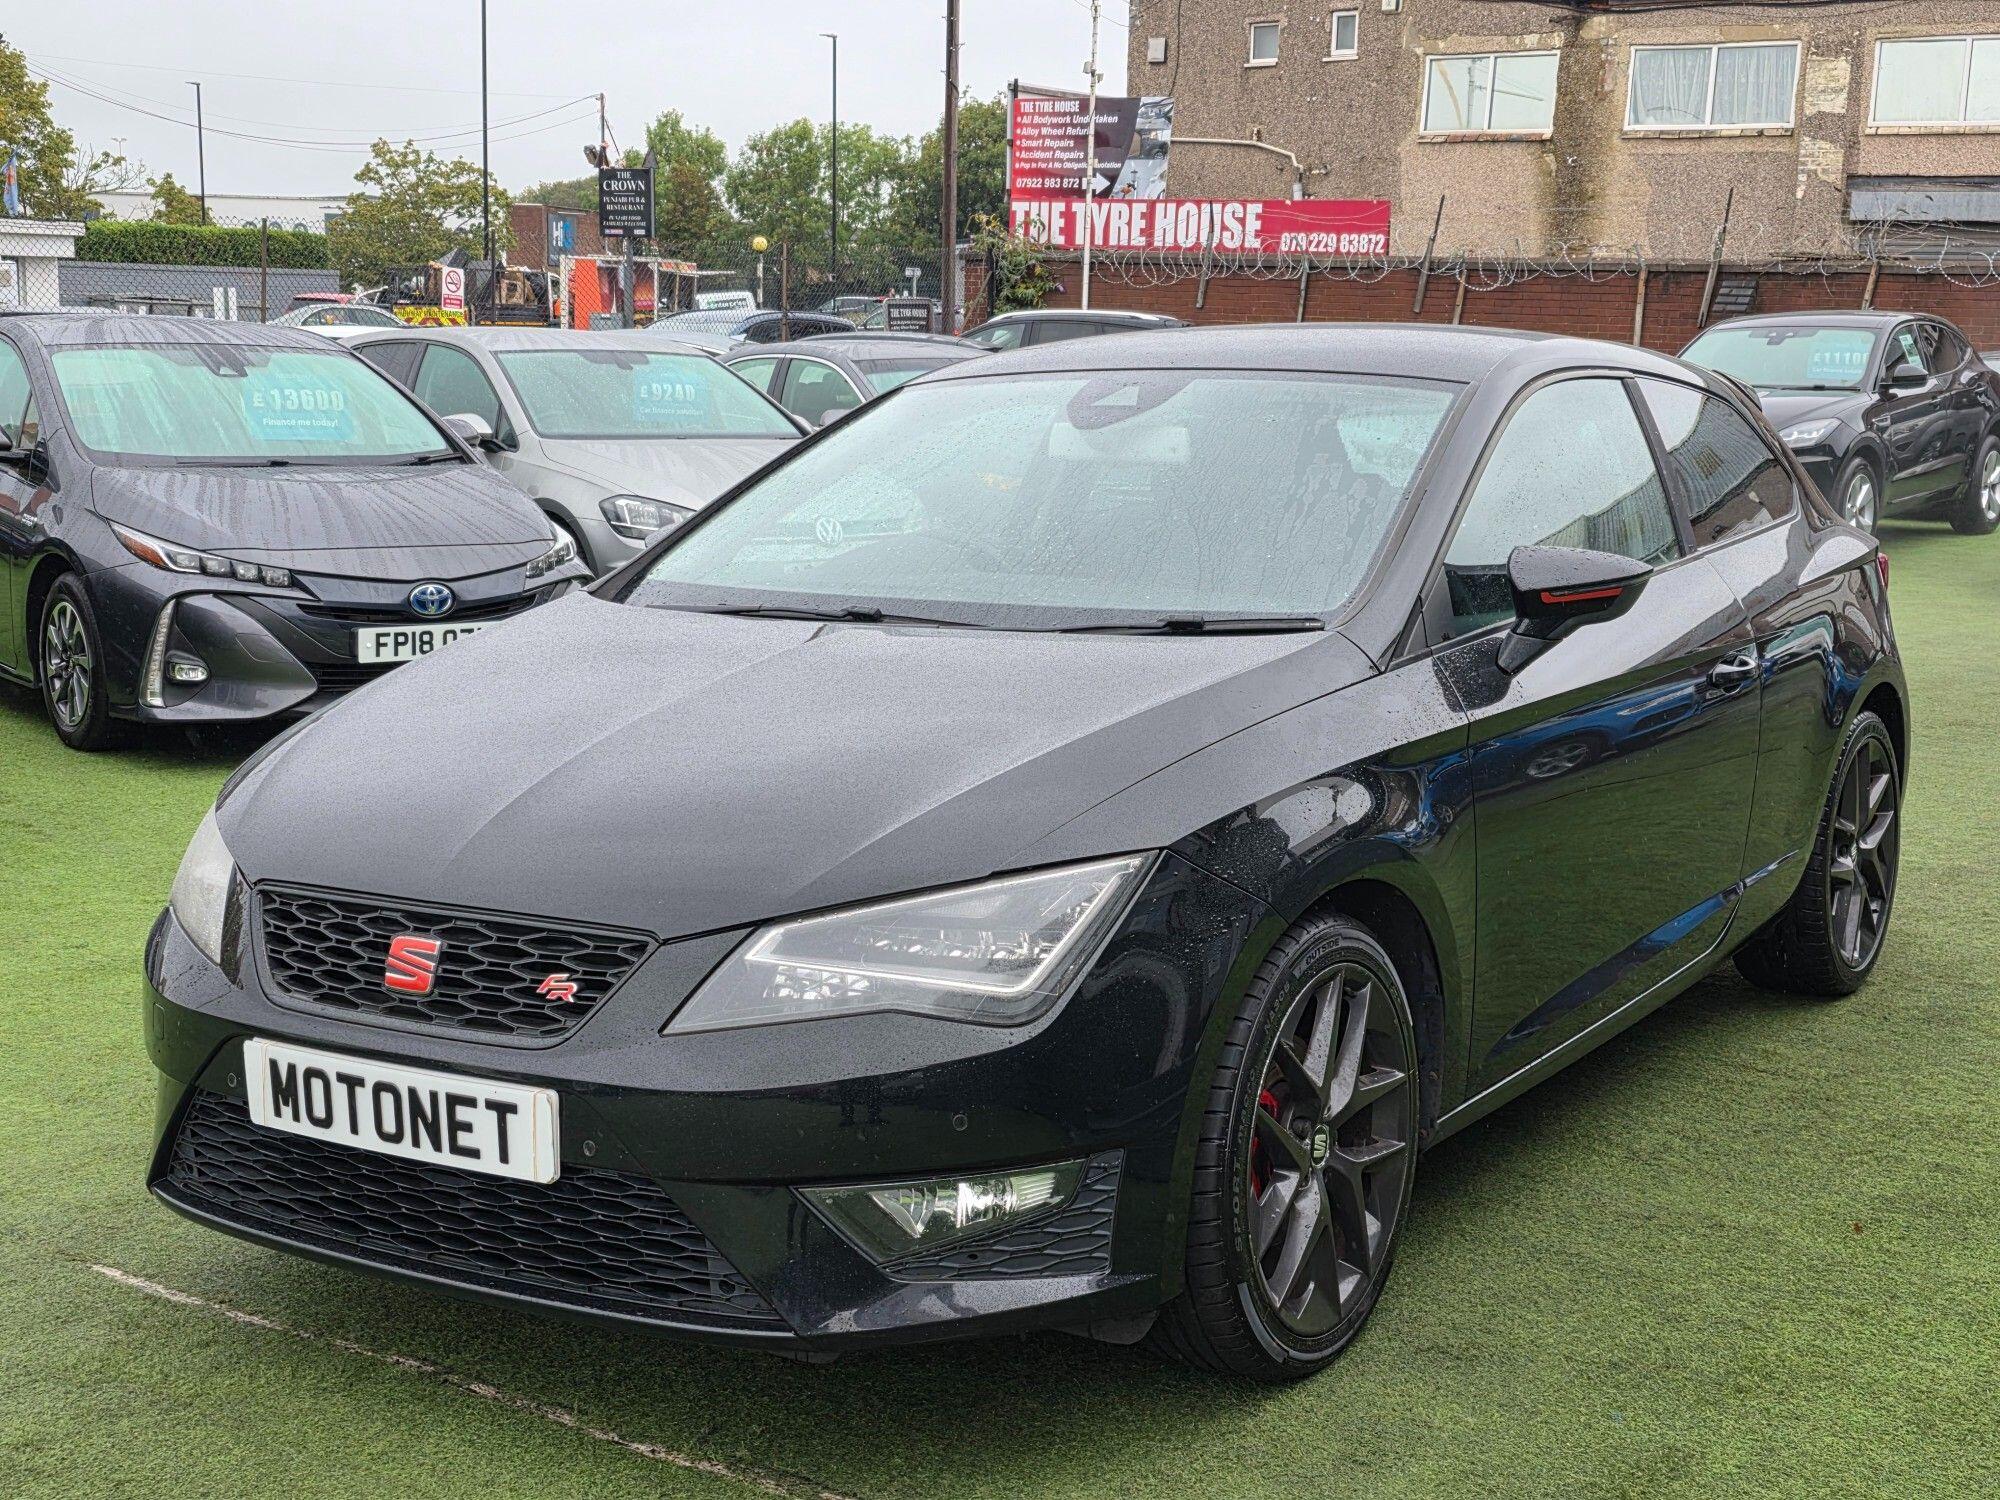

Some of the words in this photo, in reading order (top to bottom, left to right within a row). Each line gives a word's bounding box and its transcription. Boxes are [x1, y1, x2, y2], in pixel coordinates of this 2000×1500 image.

[1020, 101, 1033, 112] THE
[1035, 101, 1053, 112] TYRE
[1054, 101, 1080, 112] HOUSE
[1022, 115, 1032, 124] All
[1033, 115, 1070, 125] Bodywork
[1073, 115, 1118, 123] Undrtaken
[1021, 127, 1039, 136] Alloy
[1041, 127, 1064, 135] Wheel
[1021, 139, 1042, 147] Smart
[1044, 139, 1074, 149] Repairs
[1020, 151, 1053, 159] Accident
[1054, 151, 1084, 160] Repairs
[616, 171, 632, 179] THE
[603, 180, 645, 191] CROWN
[1016, 178, 1042, 188] 07922
[1044, 178, 1060, 188] 983
[1062, 178, 1079, 188] 872
[1011, 202, 1066, 245] THE
[1072, 202, 1149, 247] TYRE
[1154, 203, 1262, 249] HOUSE
[1281, 233, 1307, 252] 079
[1308, 233, 1337, 253] 229
[1340, 234, 1385, 253] 83872
[263, 417, 296, 426] Finance
[269, 1058, 518, 1164] MOTONET
